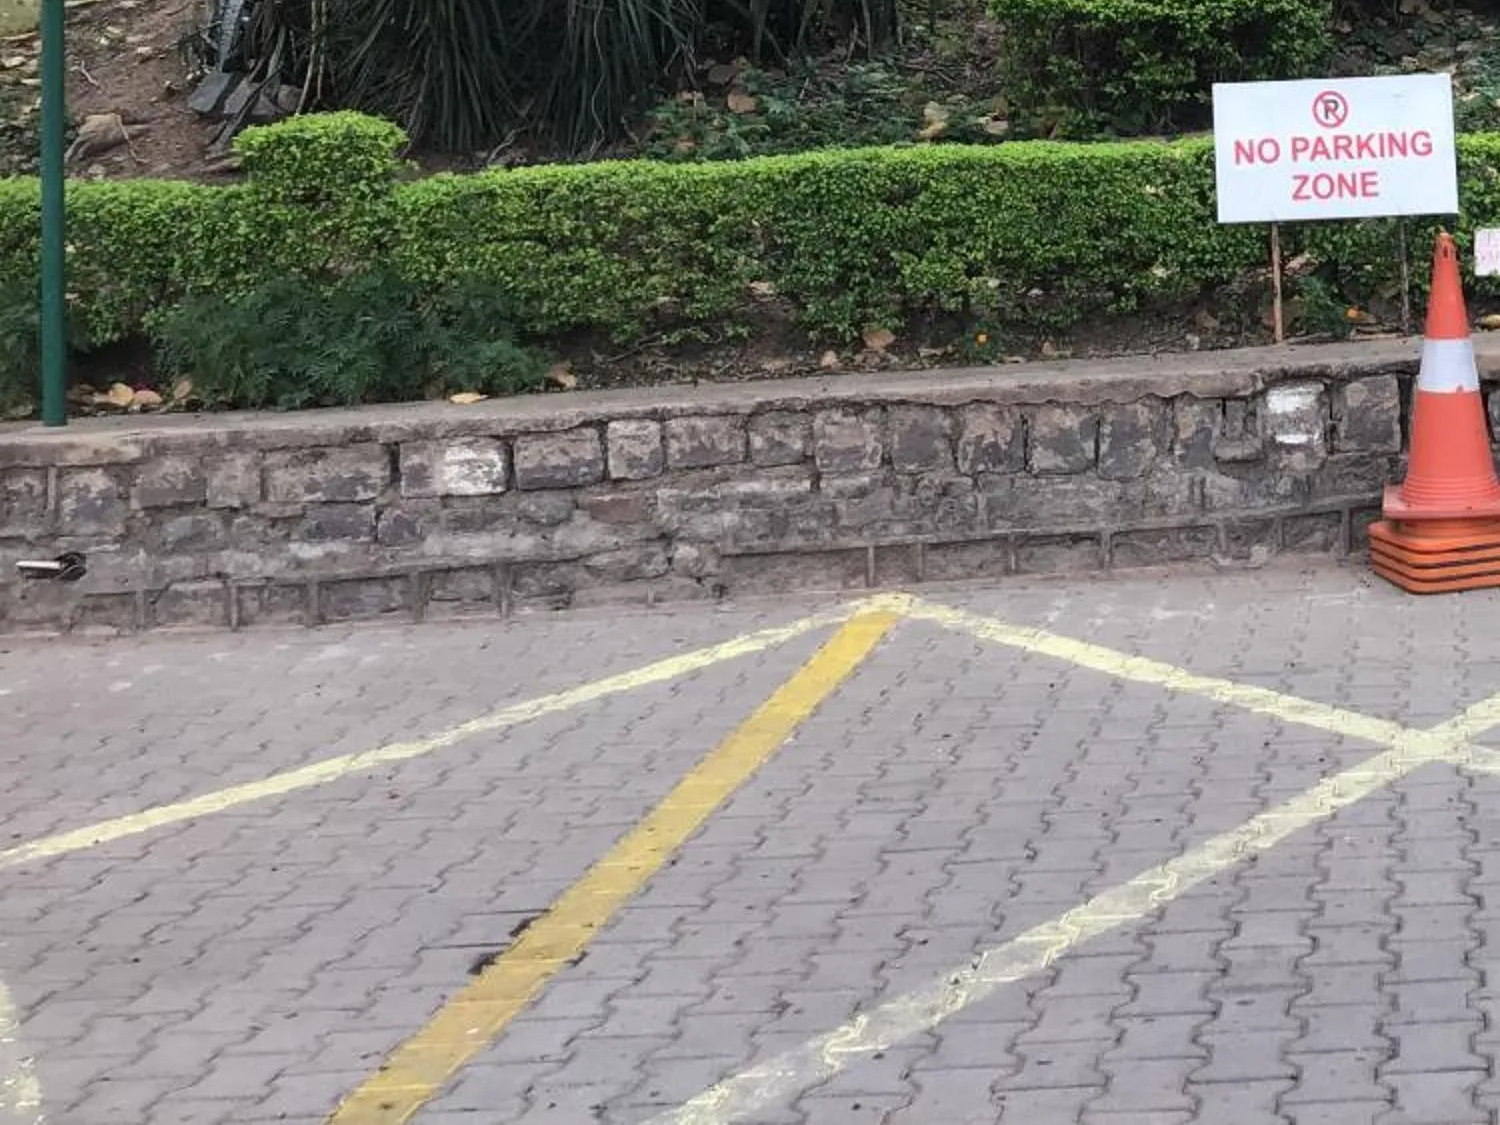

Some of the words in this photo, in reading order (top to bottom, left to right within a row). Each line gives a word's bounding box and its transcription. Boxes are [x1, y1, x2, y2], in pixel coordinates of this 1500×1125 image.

[1234, 137, 1281, 165] NO
[1290, 130, 1434, 162] PARKING
[1292, 171, 1380, 201] ZONE
